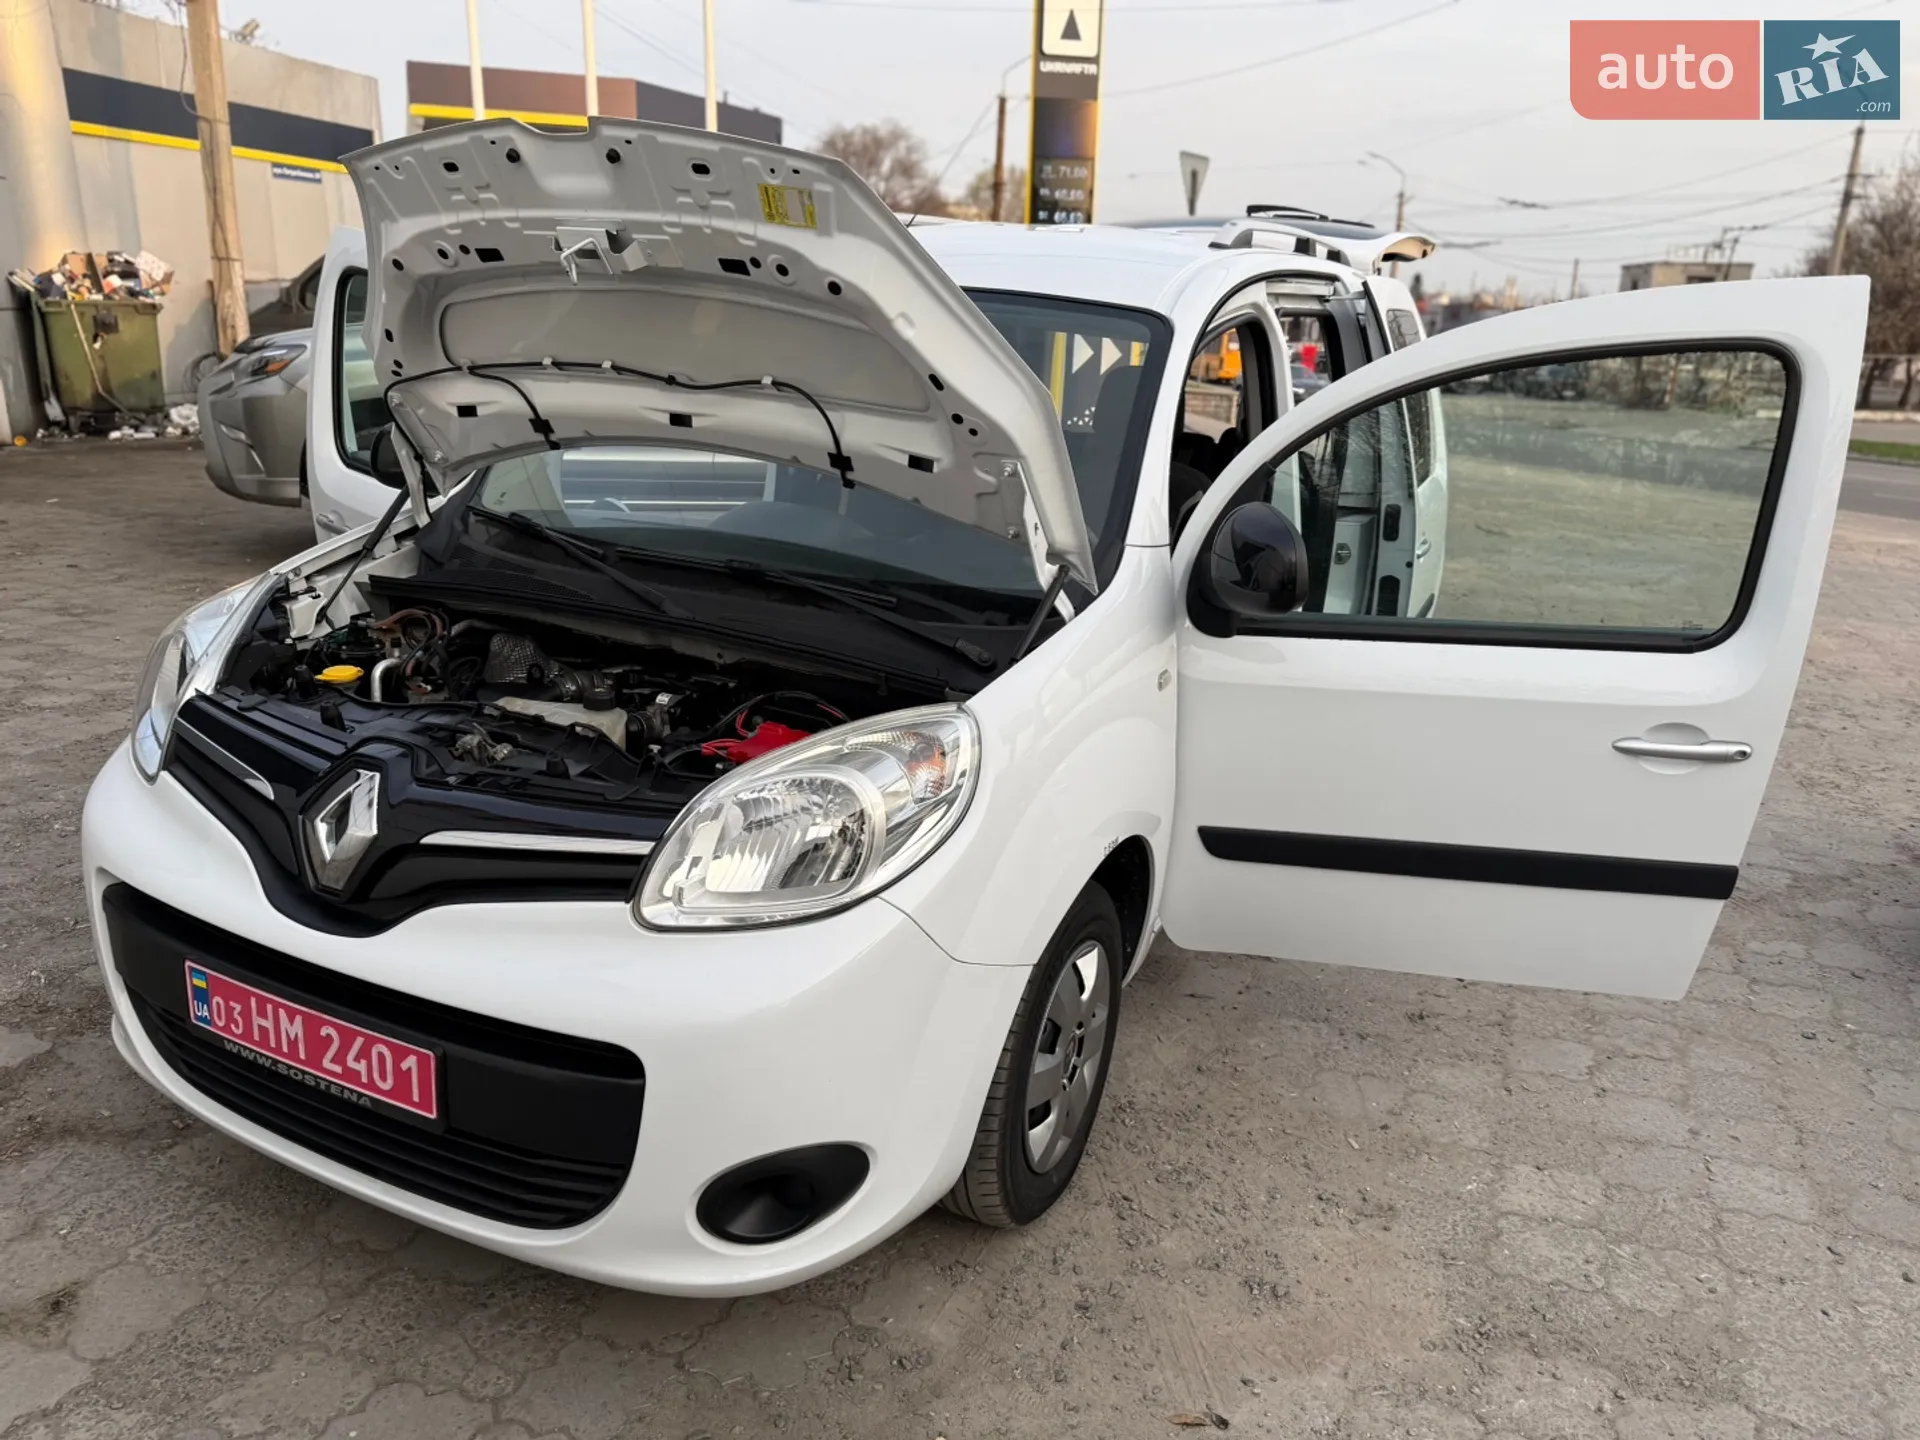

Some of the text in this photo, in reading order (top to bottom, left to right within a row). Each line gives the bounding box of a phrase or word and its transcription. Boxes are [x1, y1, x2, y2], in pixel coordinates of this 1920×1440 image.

[194, 1000, 210, 1020] UA
[212, 996, 421, 1103] 03 HM 2401
